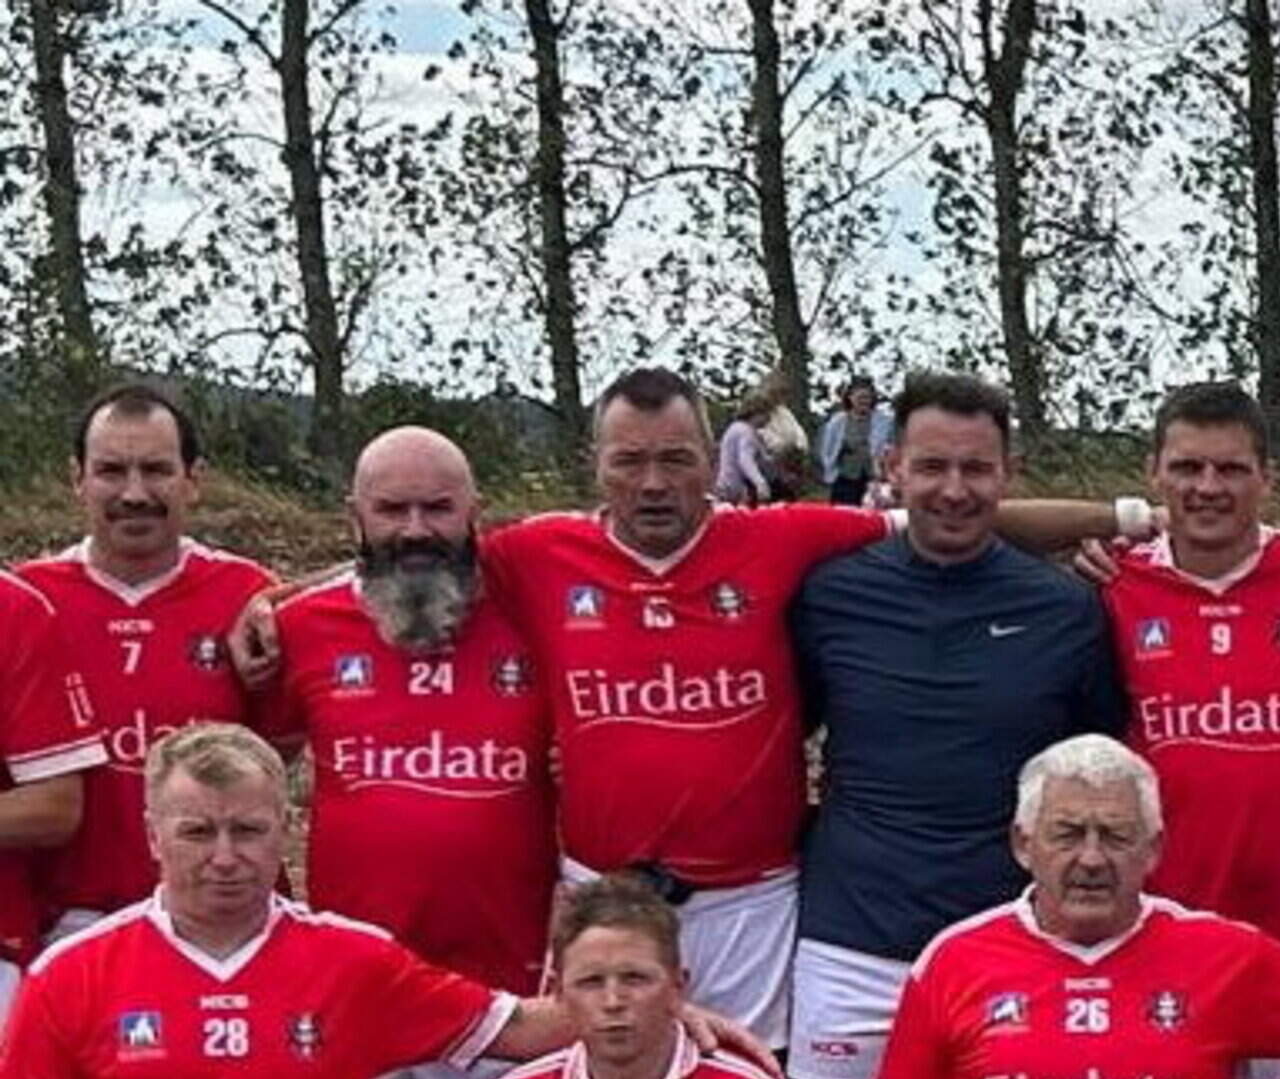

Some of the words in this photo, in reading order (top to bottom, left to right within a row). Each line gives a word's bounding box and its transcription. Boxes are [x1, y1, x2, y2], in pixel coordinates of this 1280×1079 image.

[1210, 623, 1231, 655] 9
[121, 640, 142, 674] 7
[408, 662, 453, 695] 24
[566, 663, 767, 718] Eirdata
[333, 731, 528, 782] Eirdata
[1065, 998, 1110, 1033] 26
[203, 1017, 249, 1057] 28
